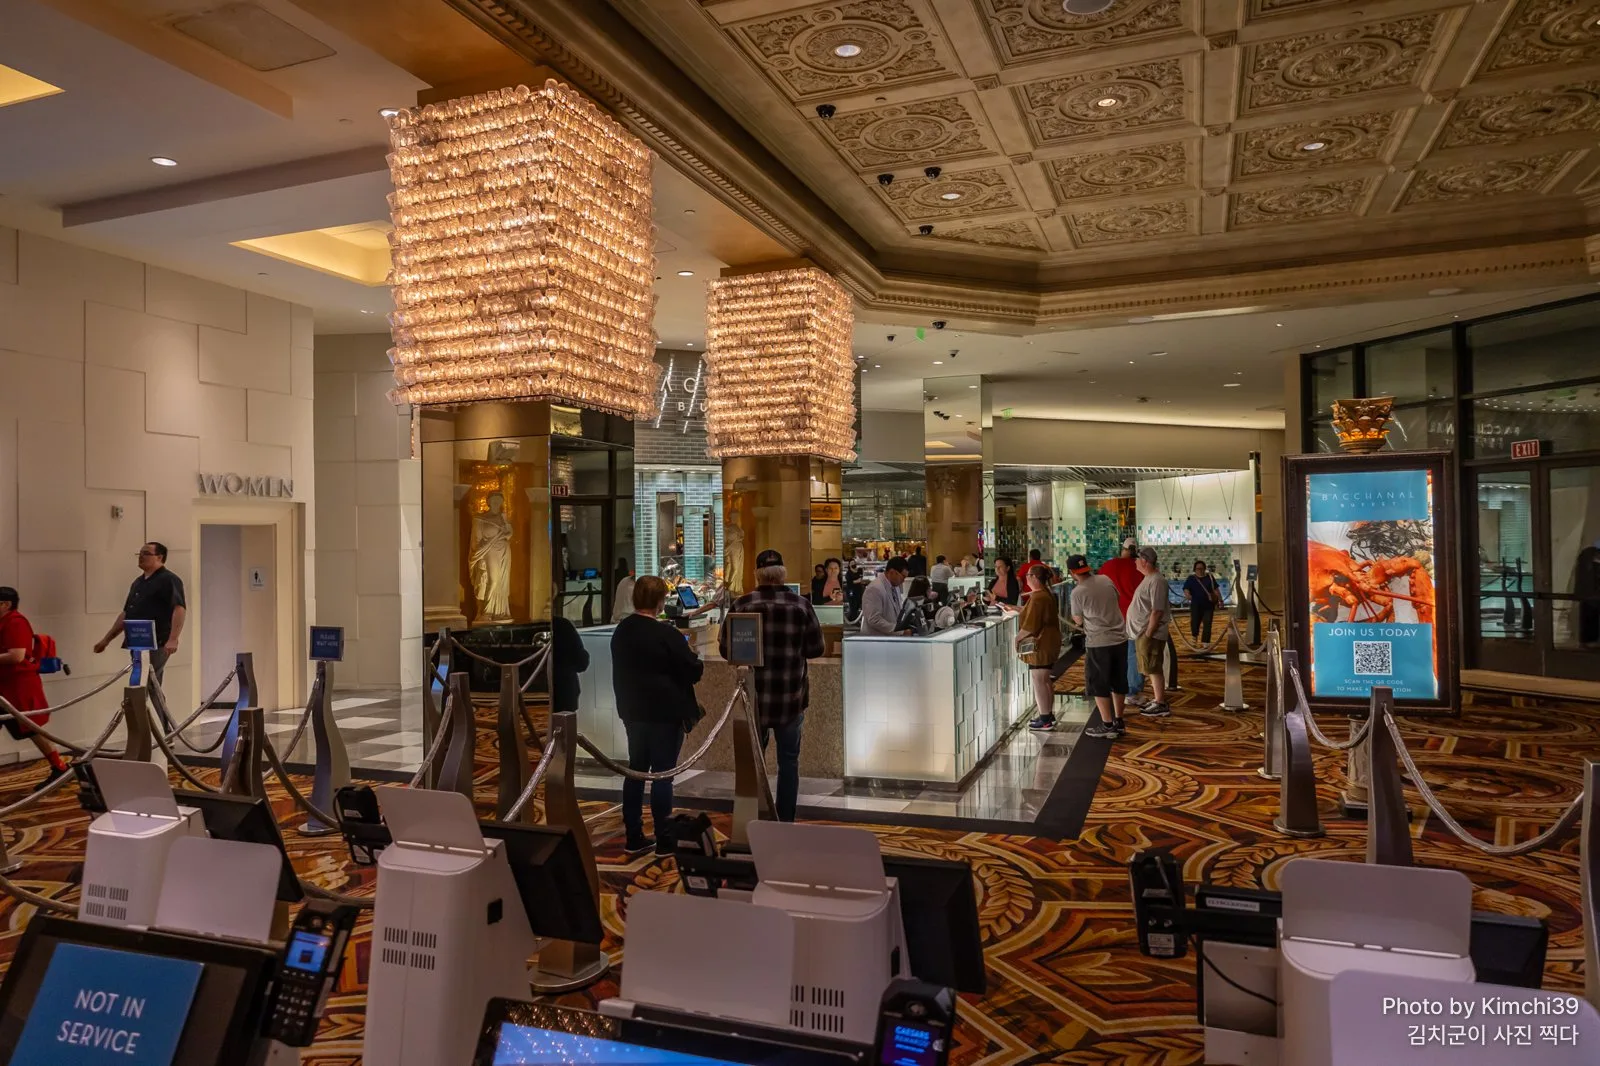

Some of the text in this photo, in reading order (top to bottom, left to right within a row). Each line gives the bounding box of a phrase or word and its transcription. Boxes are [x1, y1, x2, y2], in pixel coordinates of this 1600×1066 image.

[1515, 442, 1536, 457] EXIT
[197, 473, 293, 498] WOMEN
[1322, 491, 1415, 501] BACCHANAL
[1329, 628, 1418, 637] JOIN US TODAY
[74, 988, 146, 1018] NOT IN
[57, 1020, 140, 1054] SERVICE
